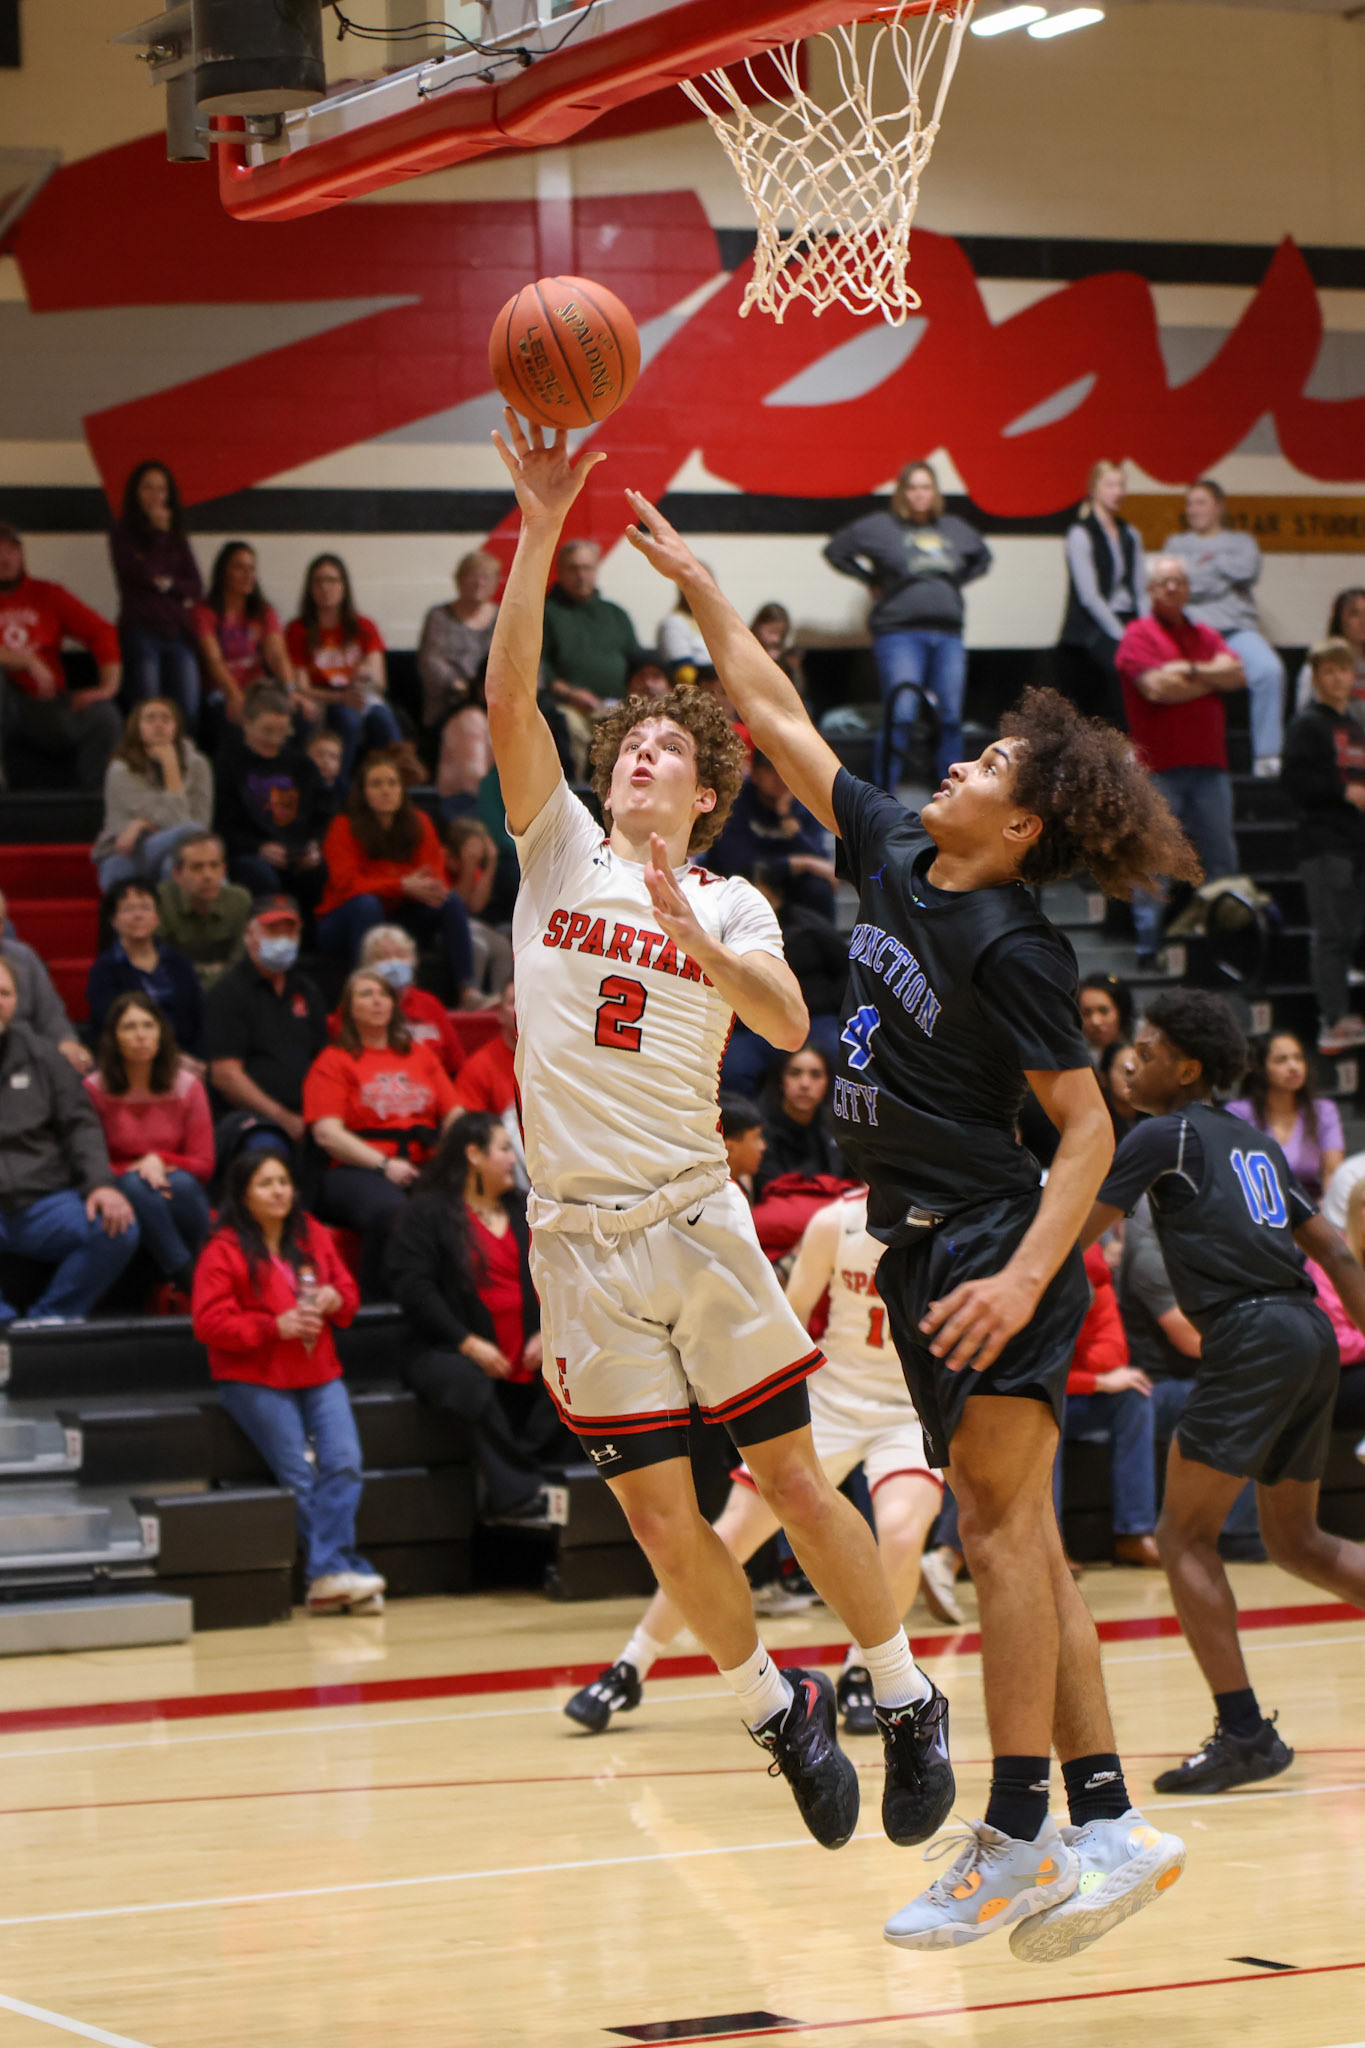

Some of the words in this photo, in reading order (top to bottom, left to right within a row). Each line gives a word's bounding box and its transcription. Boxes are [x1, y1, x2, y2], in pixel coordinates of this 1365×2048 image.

[526, 324, 571, 405] LEGACY
[553, 300, 614, 399] SPALDING
[542, 908, 714, 988] SPARTAN
[594, 974, 648, 1053] 2
[840, 1004, 881, 1071] 4
[833, 1075, 879, 1126] CITY
[1230, 1148, 1289, 1228] 10
[865, 1306, 893, 1349] 1
